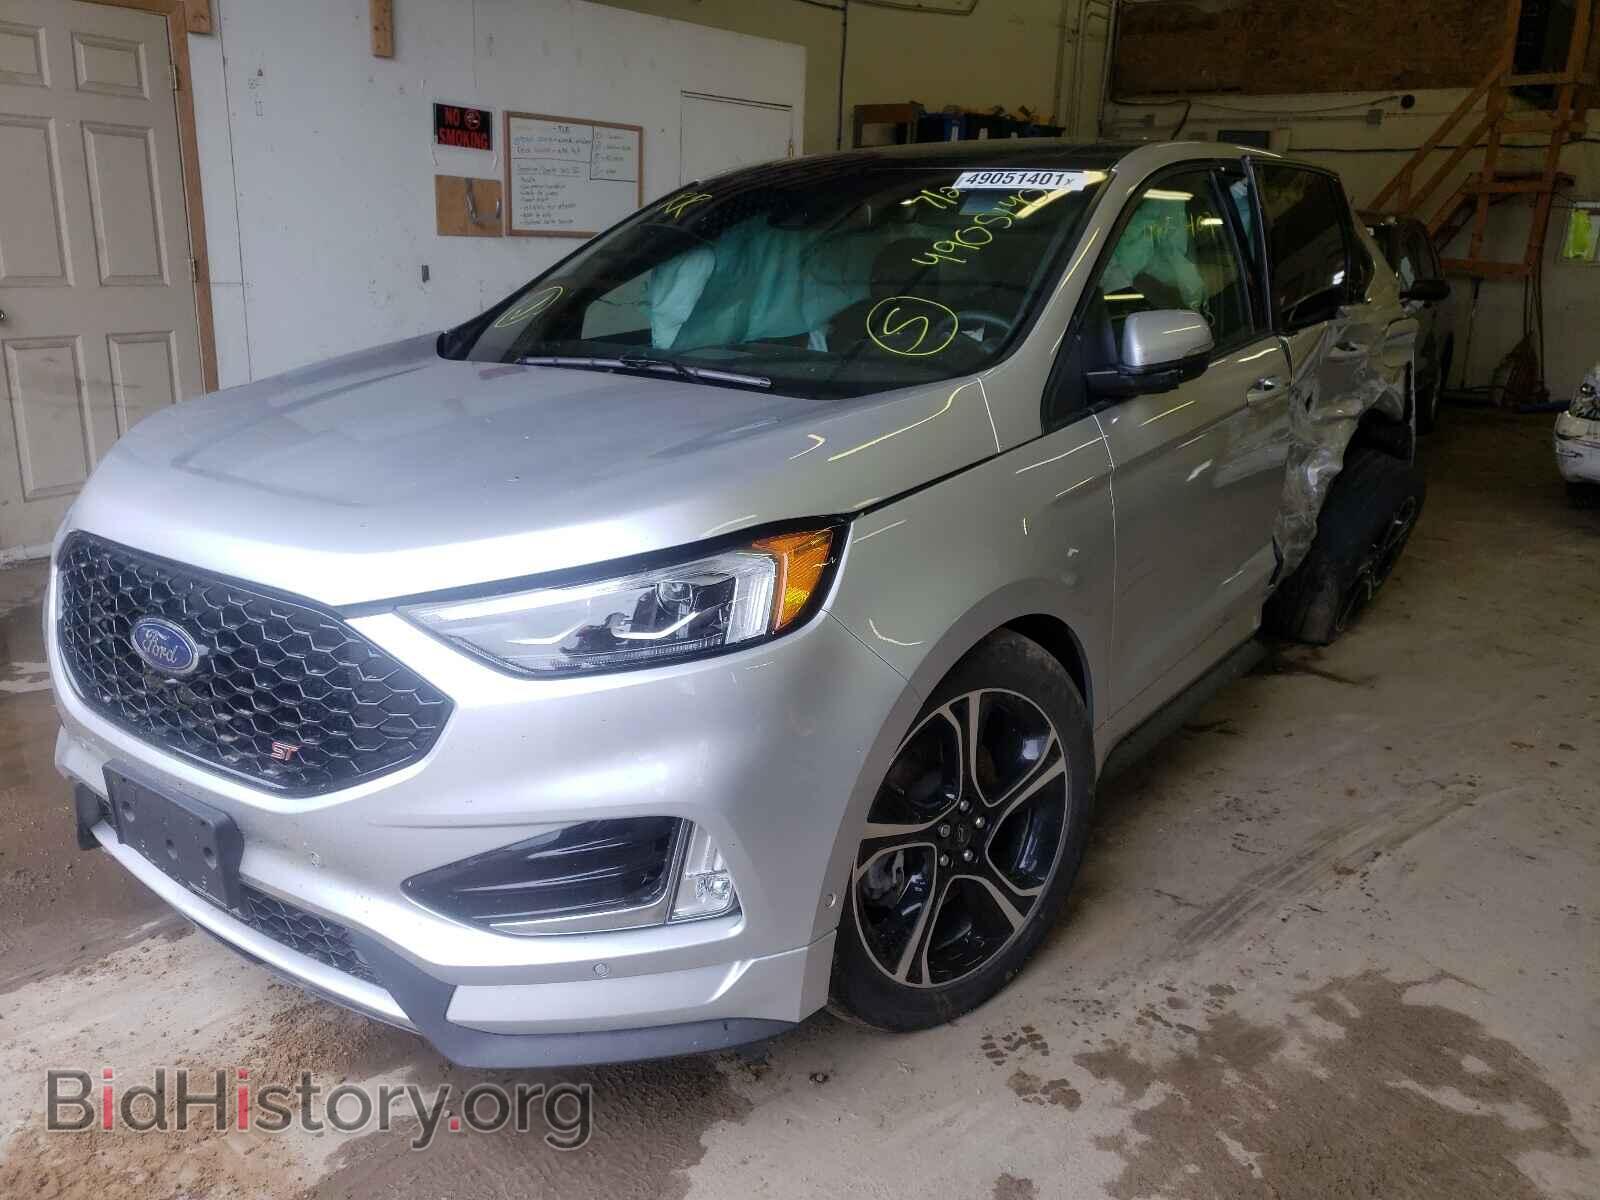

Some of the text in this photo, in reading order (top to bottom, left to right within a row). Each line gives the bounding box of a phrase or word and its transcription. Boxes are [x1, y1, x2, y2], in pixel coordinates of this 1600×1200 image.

[443, 107, 460, 126] NO
[439, 128, 488, 148] SMOKING
[965, 172, 1065, 186] 49051401
[143, 629, 177, 664] Ford
[271, 741, 300, 761] ST
